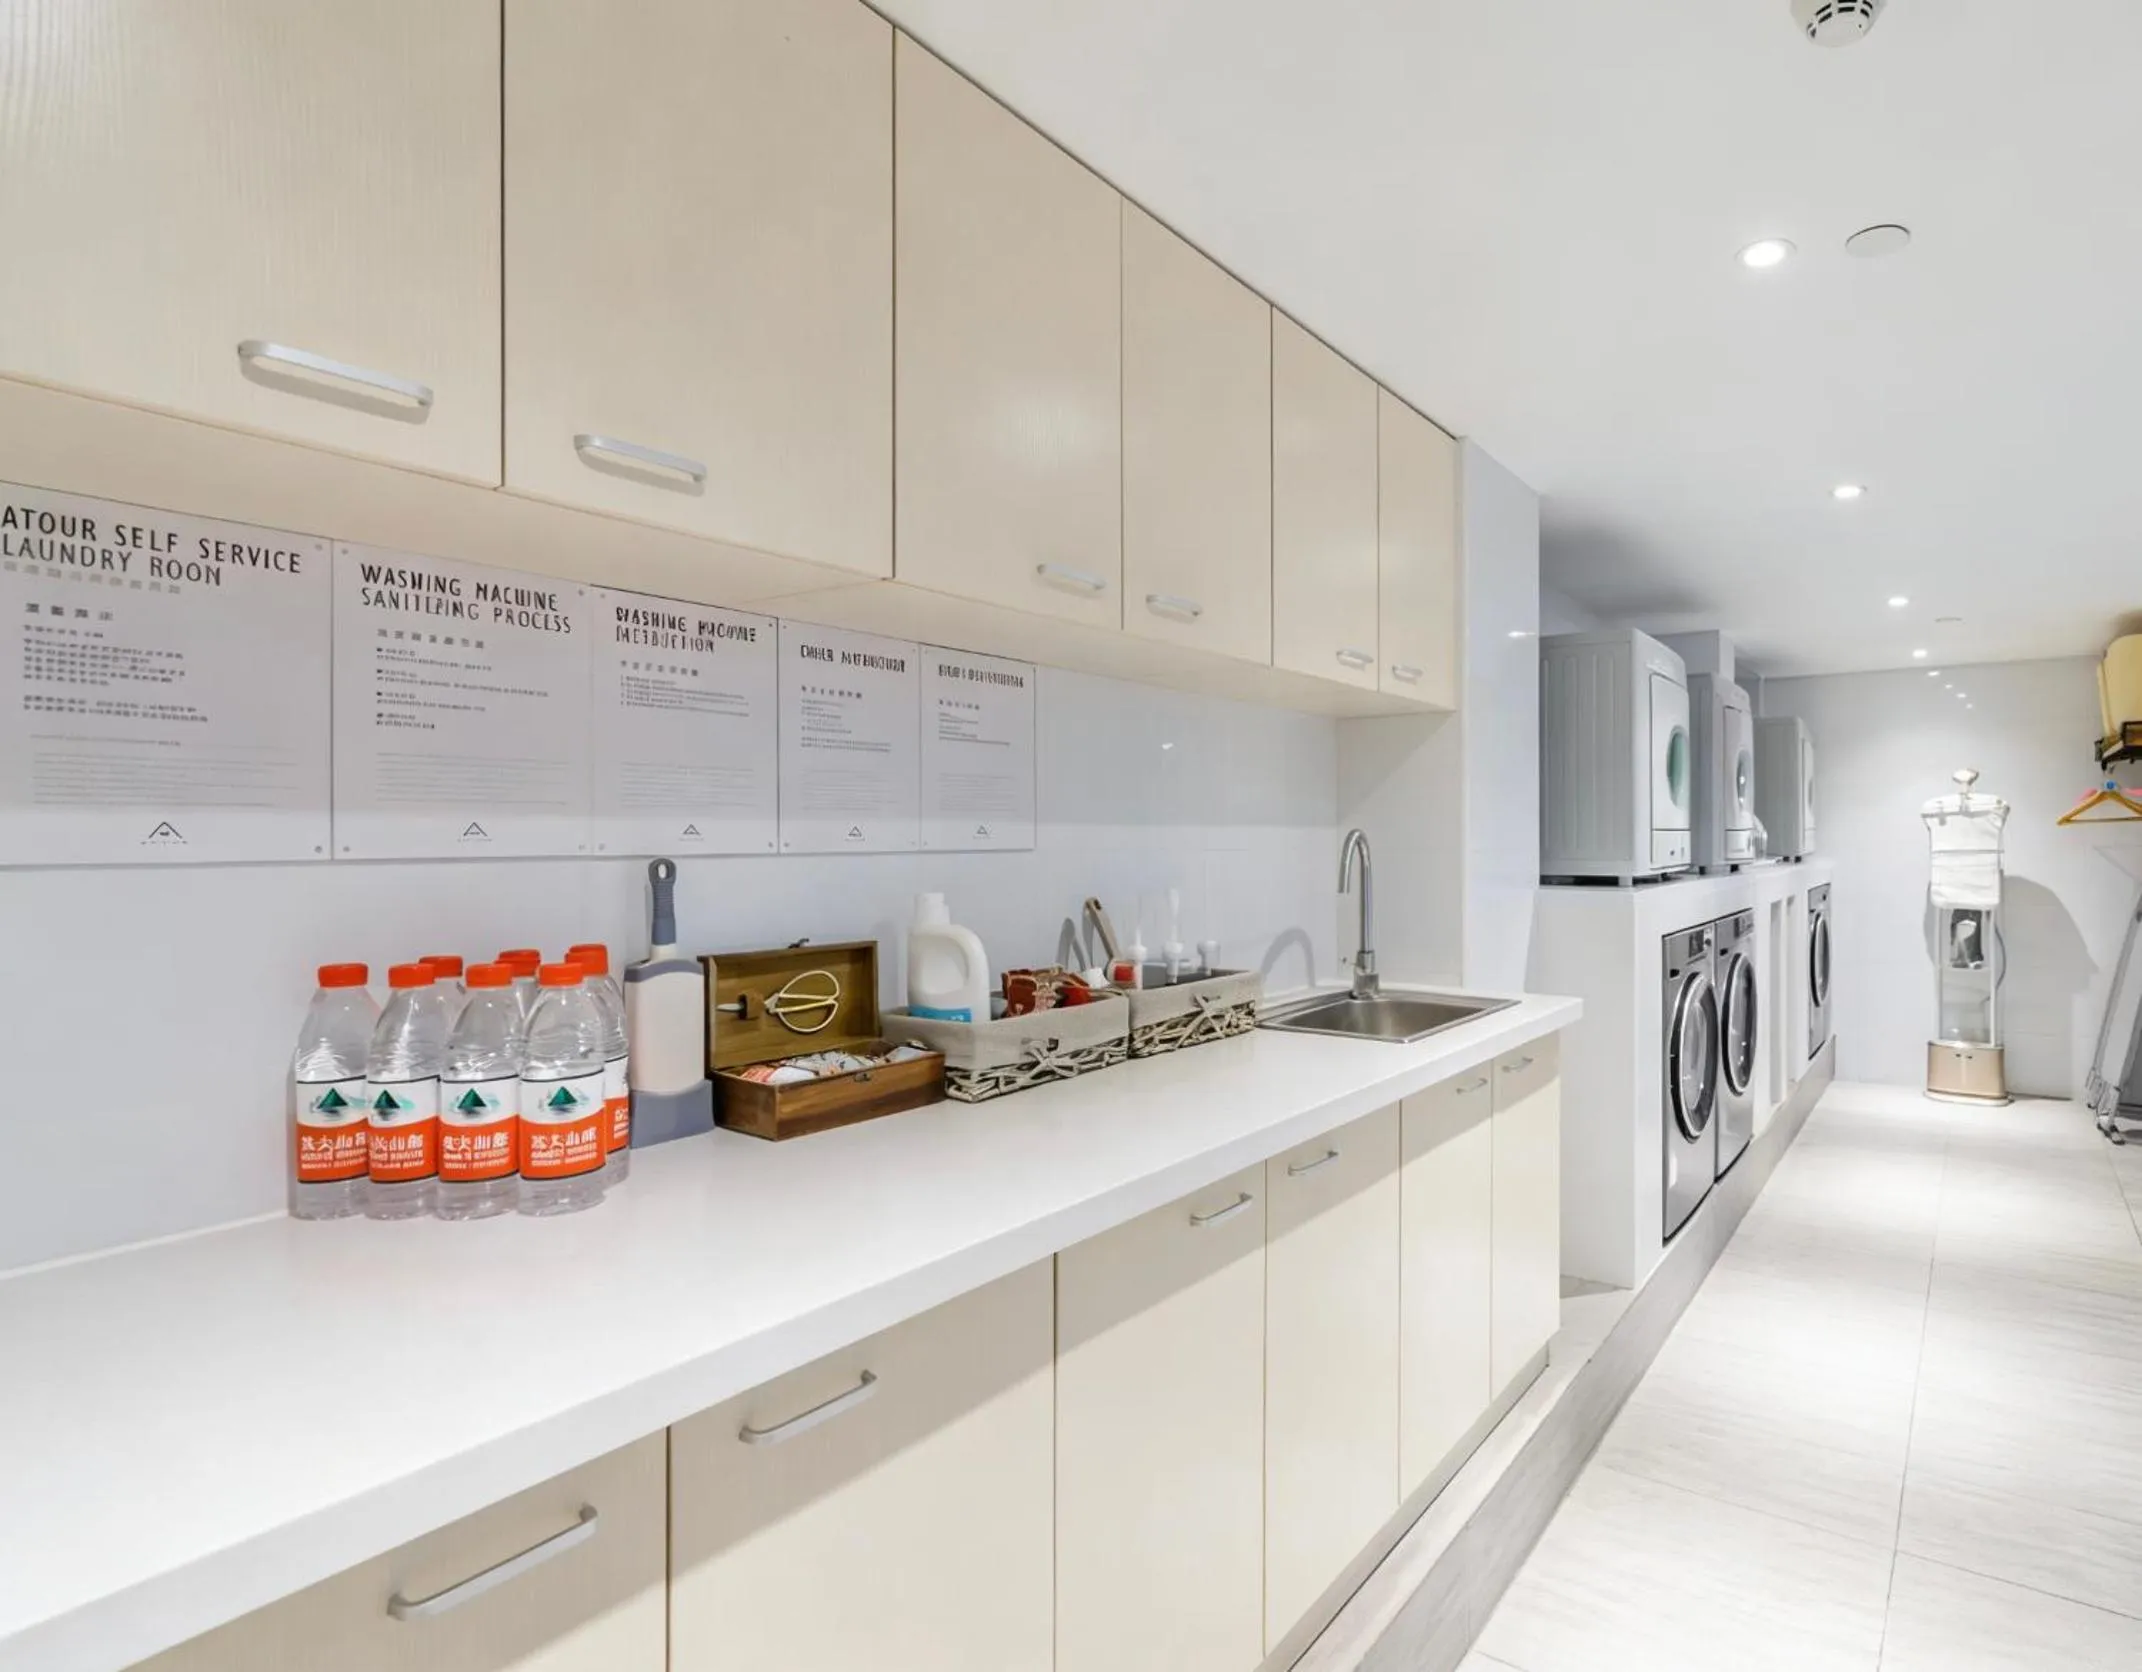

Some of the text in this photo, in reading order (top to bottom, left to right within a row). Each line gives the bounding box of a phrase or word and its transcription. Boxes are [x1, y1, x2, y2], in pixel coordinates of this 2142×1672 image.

[1, 505, 302, 574] ATOUR SELF SERVICE
[2, 533, 133, 572] LAUNDRY
